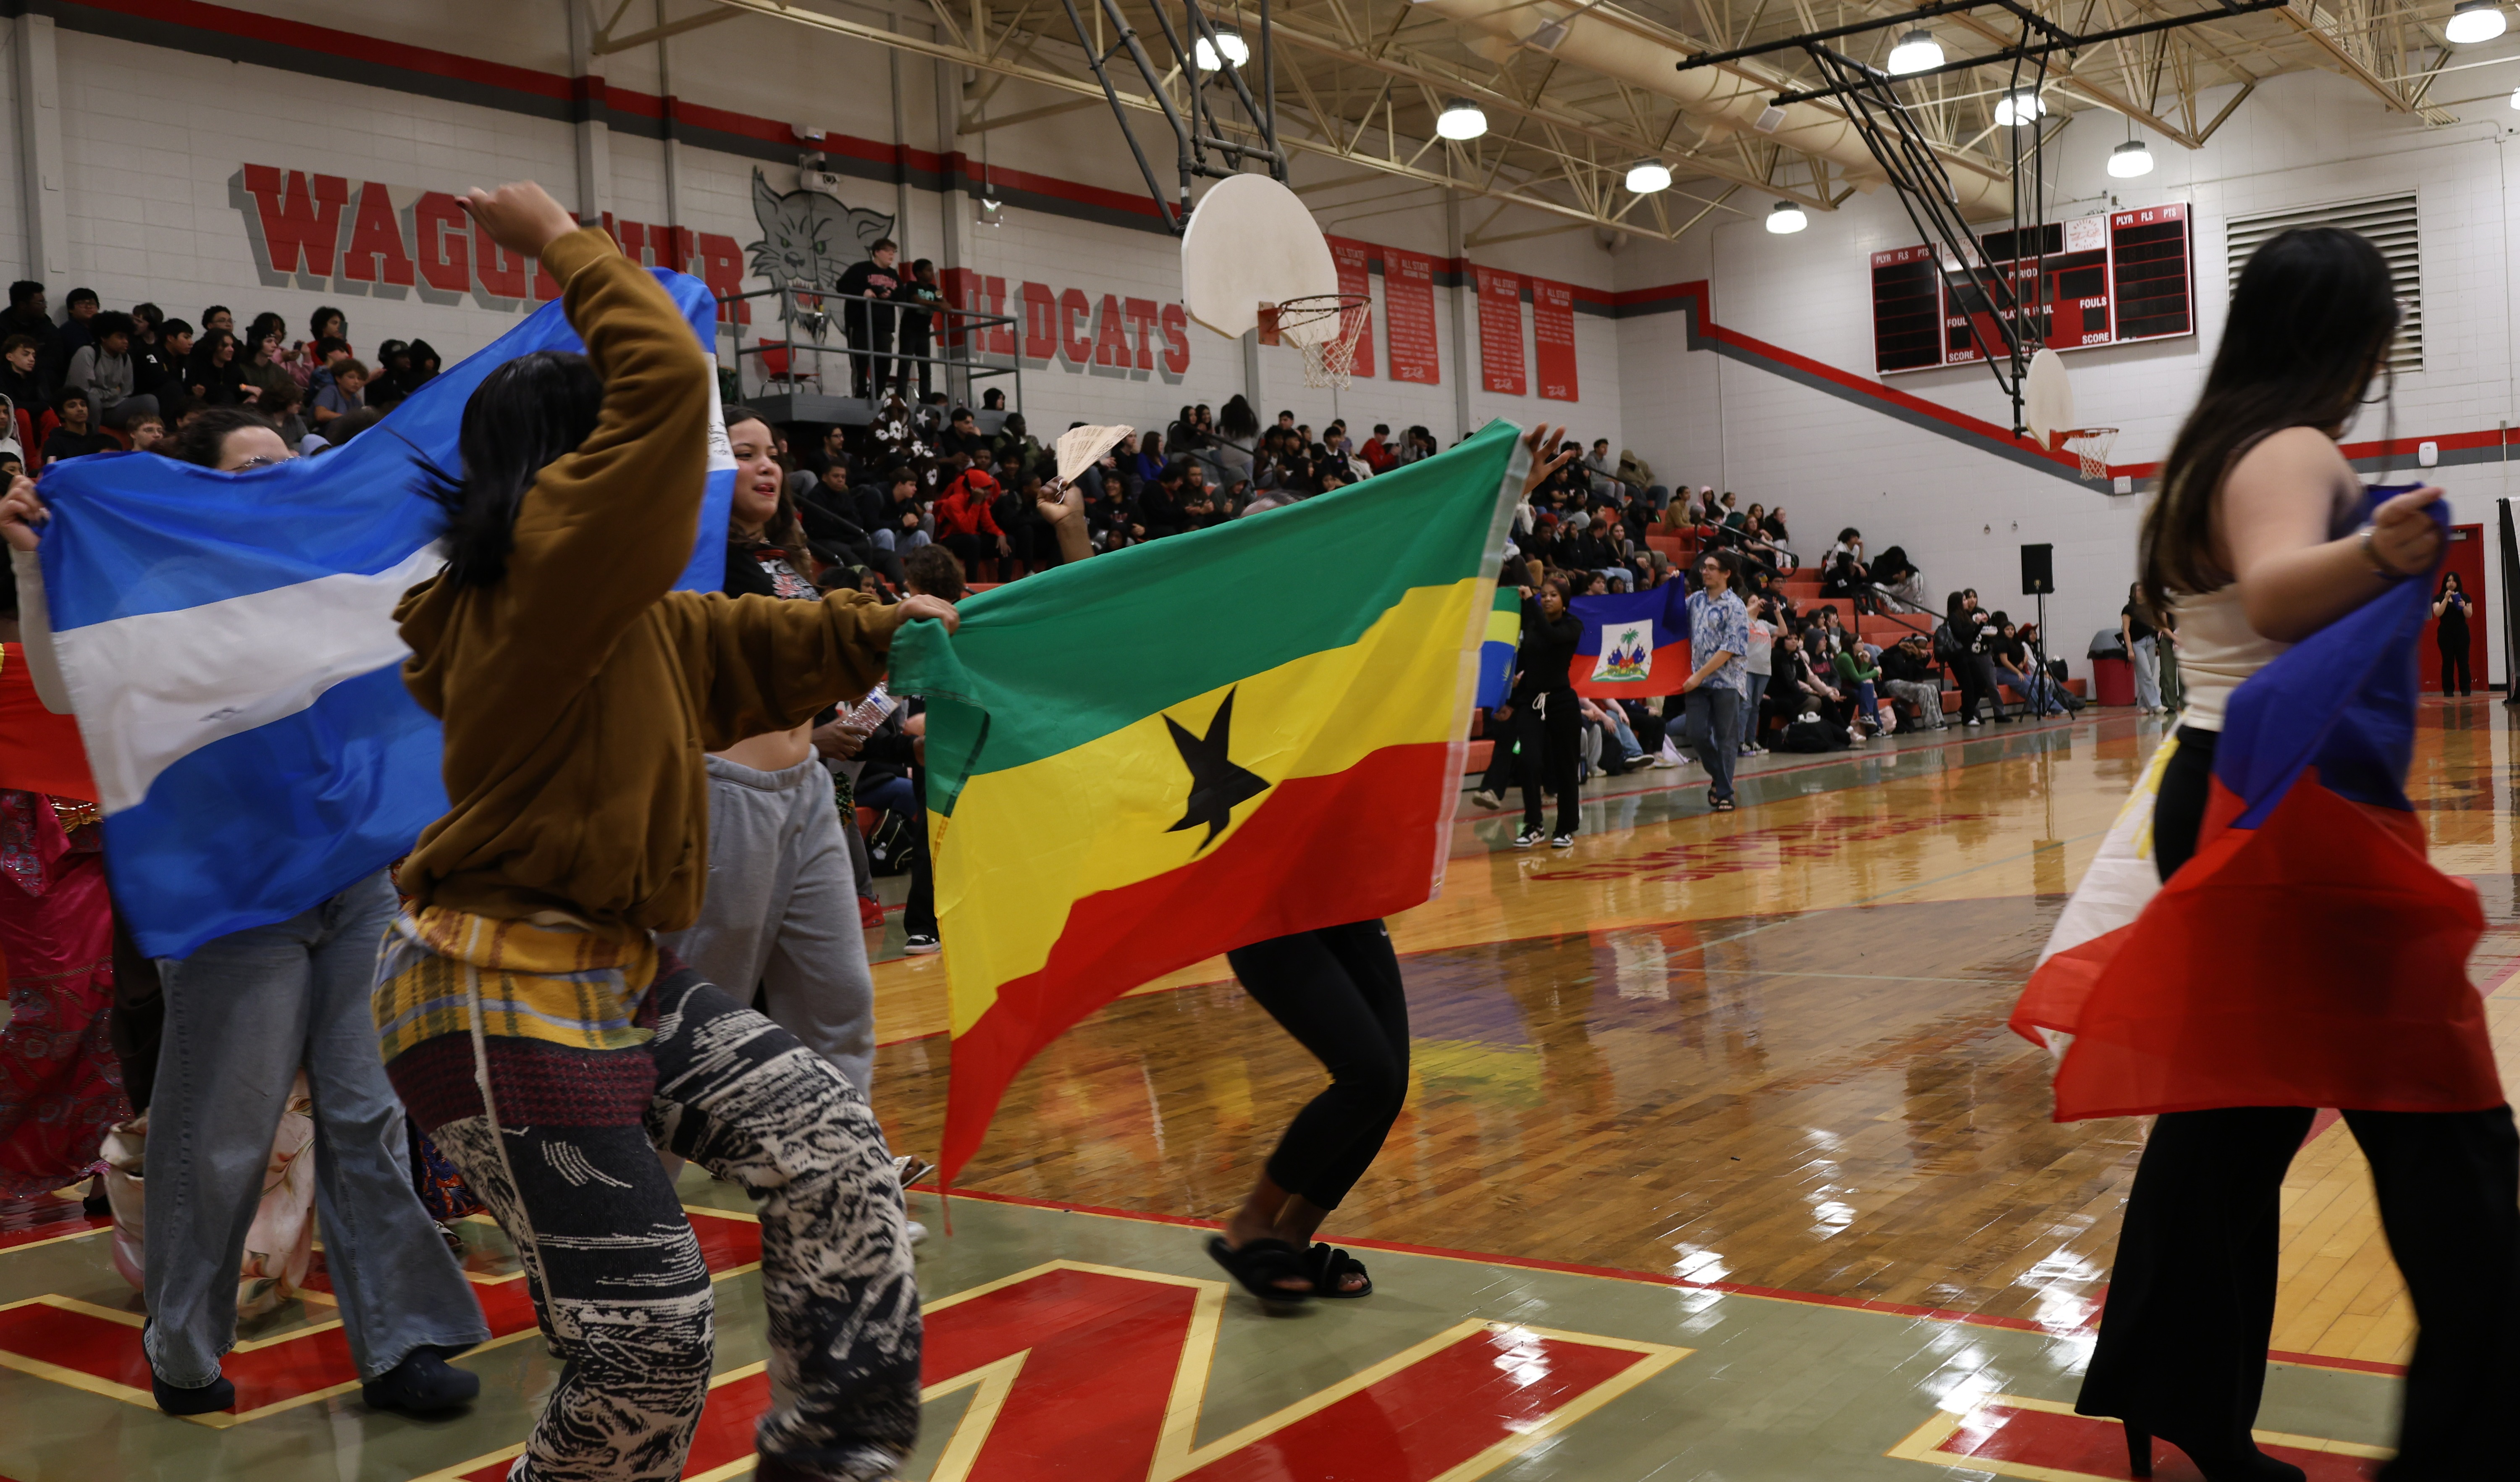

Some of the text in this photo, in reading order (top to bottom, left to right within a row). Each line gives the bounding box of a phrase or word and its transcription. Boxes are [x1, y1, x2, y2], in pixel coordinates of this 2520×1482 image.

[2116, 207, 2176, 226] PLYR FLS PTS
[1876, 248, 1929, 264] PLYR FLS PTS
[1402, 259, 1412, 269] ALL
[1412, 261, 1430, 273] STATE
[2008, 268, 2038, 281] PRIOD
[1493, 277, 1517, 290] ALL STATE
[1547, 288, 1570, 300] ALL STATE
[2079, 296, 2107, 309] FOULS
[2000, 304, 2054, 320] PLAR FUL
[1947, 316, 1972, 328] FOUL
[2082, 332, 2109, 344] SCORE
[1949, 350, 1974, 362] SCORE
